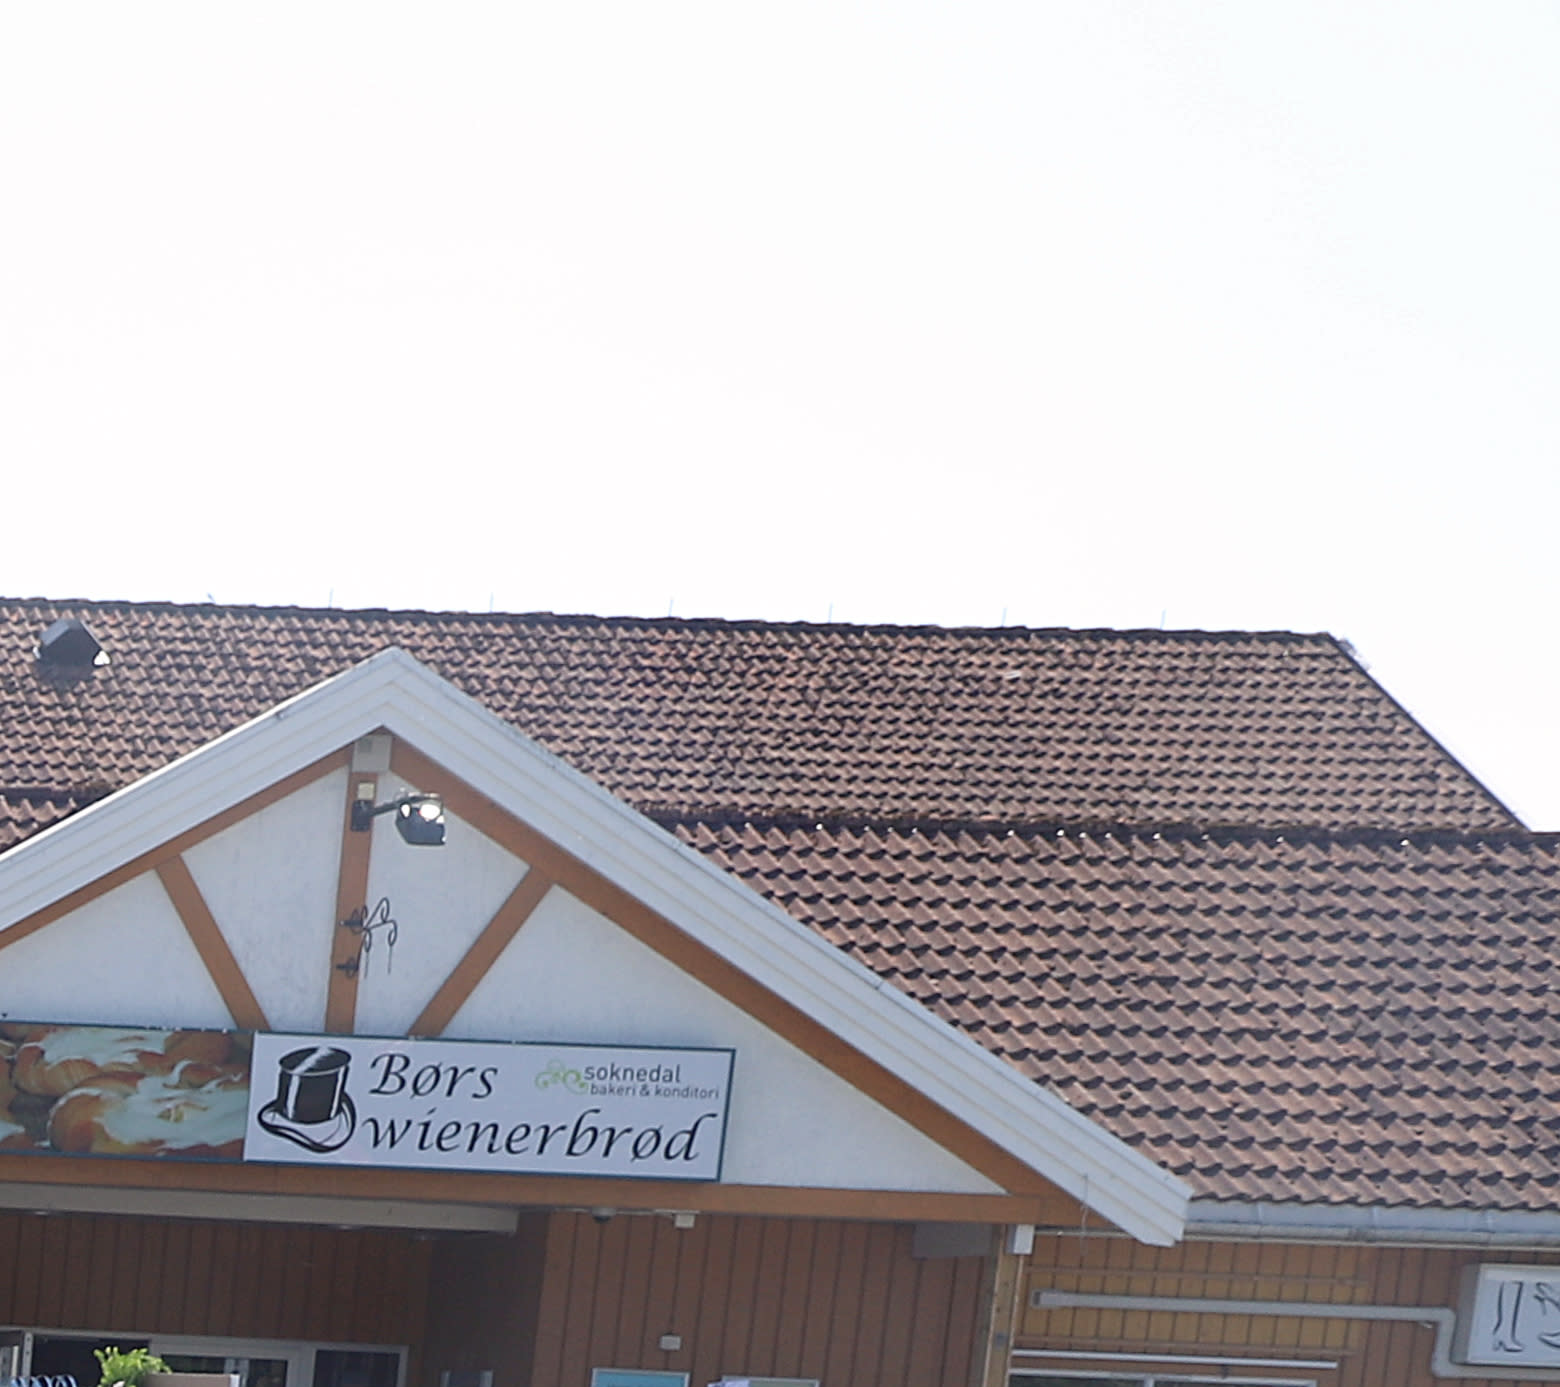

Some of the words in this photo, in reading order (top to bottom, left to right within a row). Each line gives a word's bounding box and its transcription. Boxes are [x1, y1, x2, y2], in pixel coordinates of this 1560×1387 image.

[368, 1053, 498, 1099] Børs
[584, 1062, 681, 1084] soknedal
[590, 1083, 637, 1097] bakeri
[639, 1083, 651, 1098] &
[654, 1085, 720, 1100] konditori
[361, 1107, 718, 1162] wienerbrød
